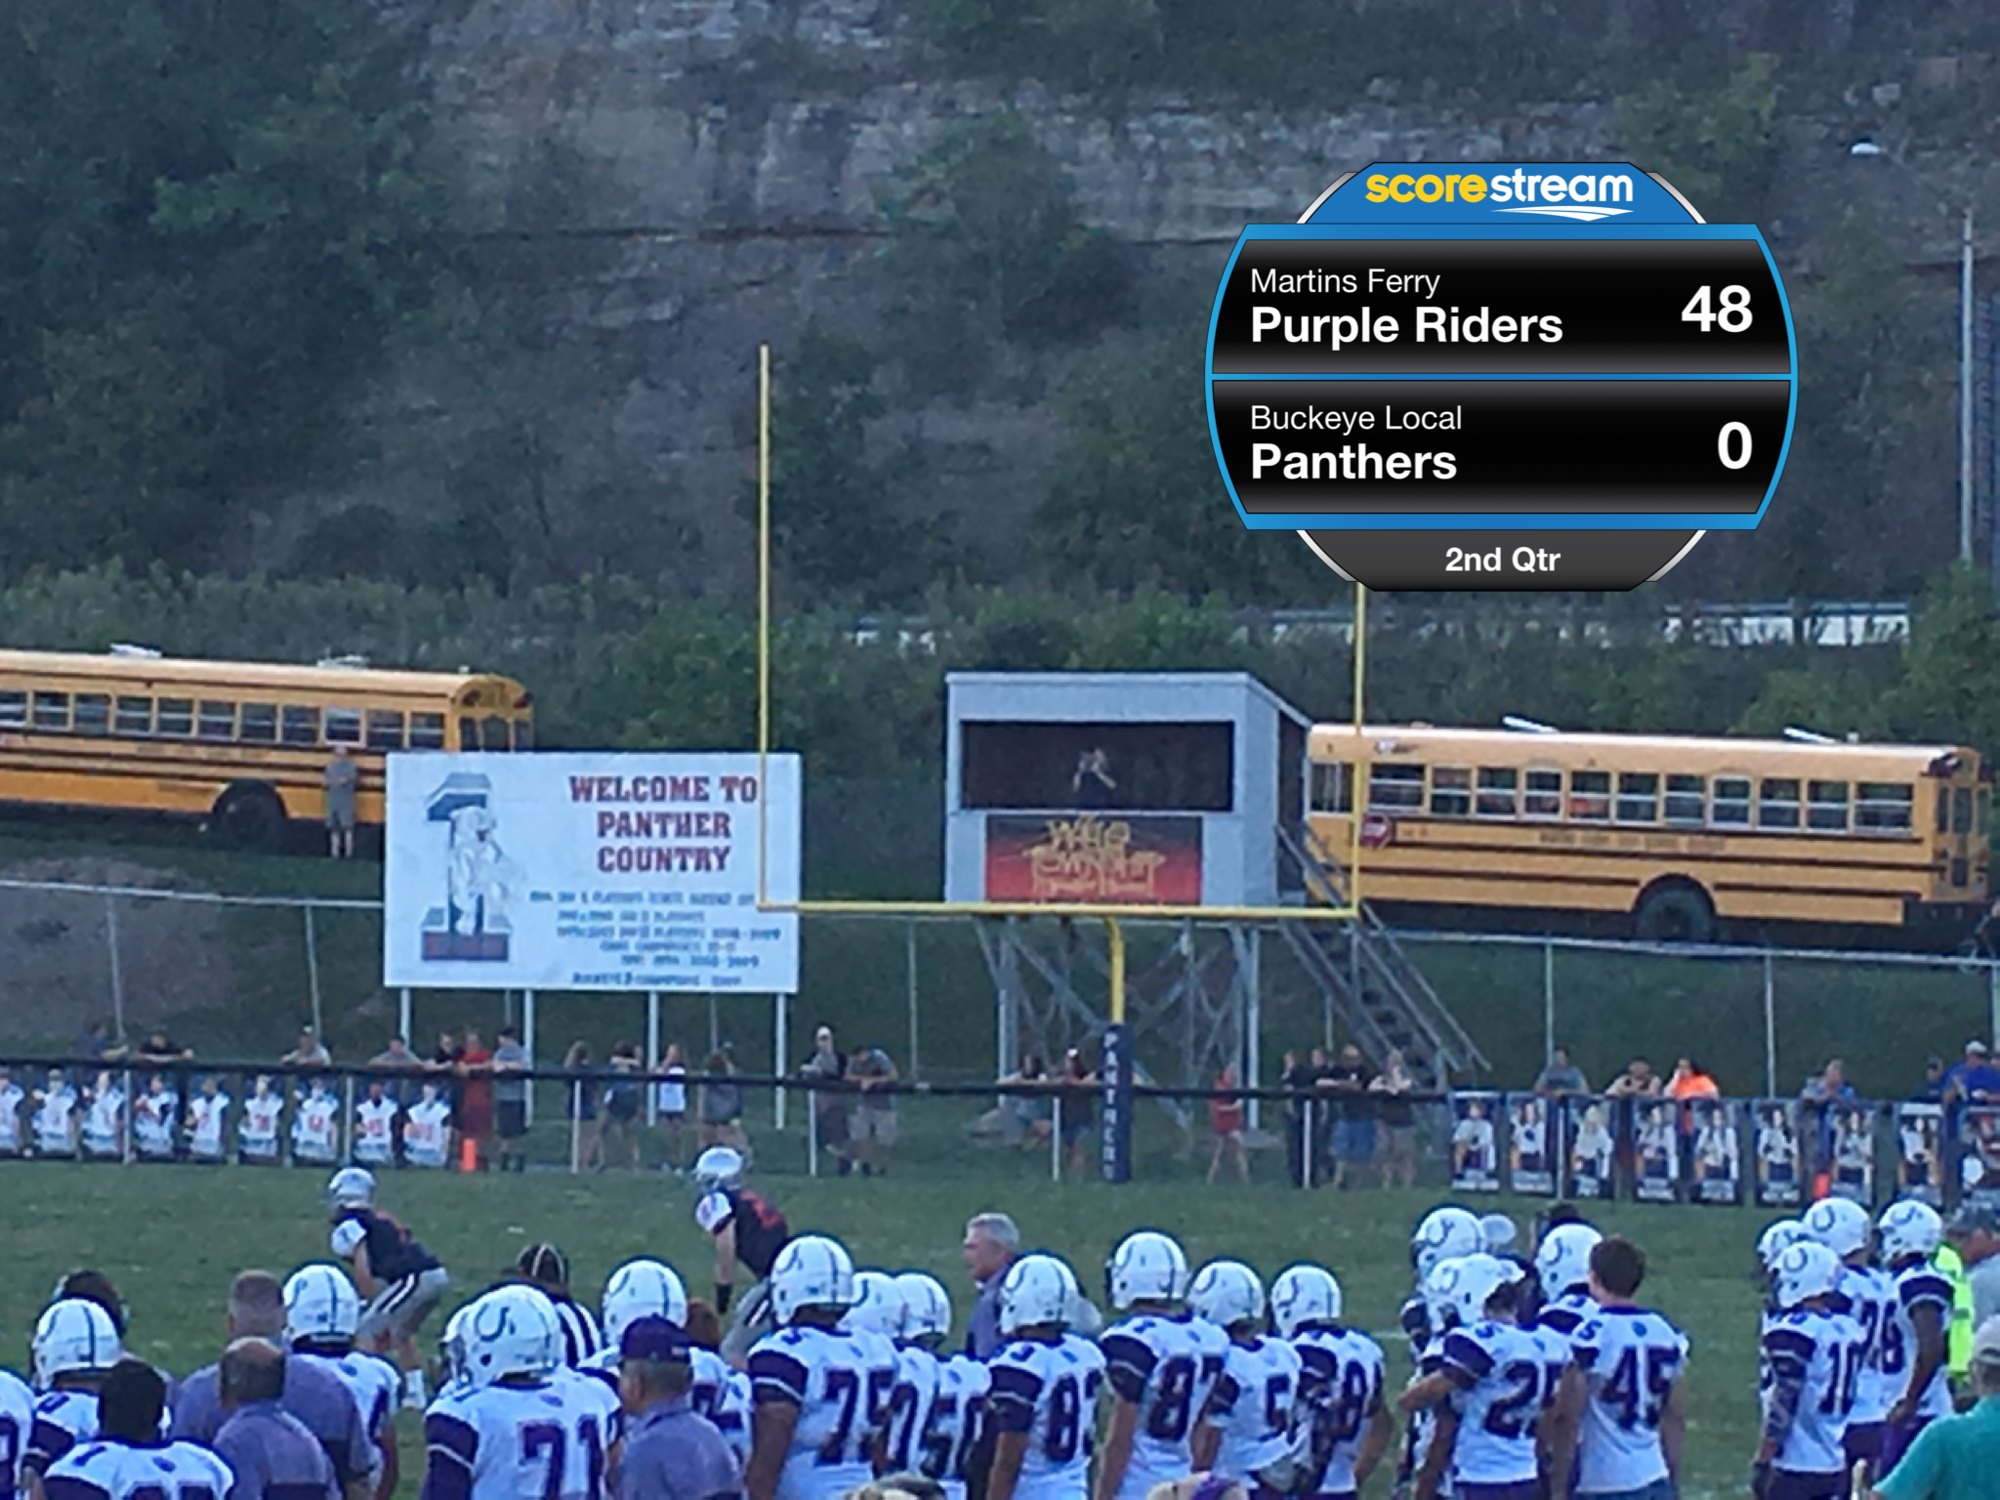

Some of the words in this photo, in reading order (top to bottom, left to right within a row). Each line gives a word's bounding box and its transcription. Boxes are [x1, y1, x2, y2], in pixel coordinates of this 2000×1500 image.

[569, 775, 710, 802] WELCOME
[720, 775, 758, 802] TO
[597, 811, 732, 838] PANTHER
[597, 846, 732, 872] COUNTRY
[1602, 1343, 1680, 1431] 45
